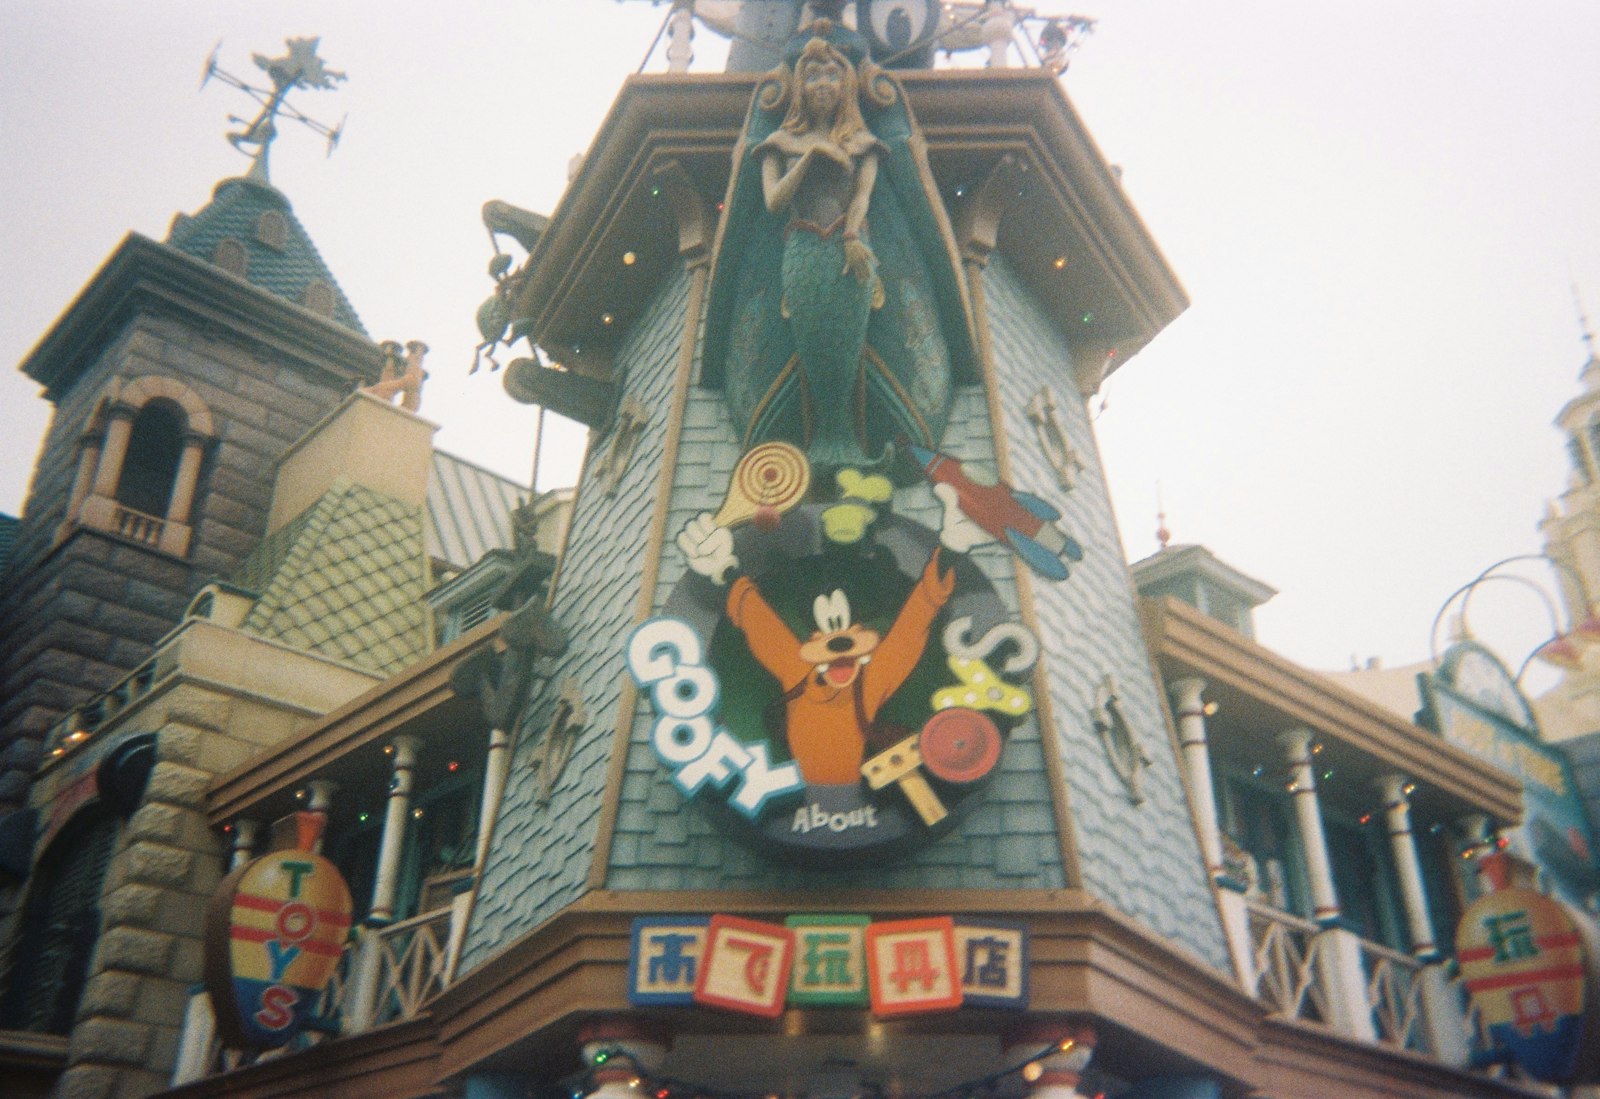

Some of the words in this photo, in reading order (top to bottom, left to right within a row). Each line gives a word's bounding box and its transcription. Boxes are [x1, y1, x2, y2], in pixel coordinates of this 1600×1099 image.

[626, 616, 803, 819] GOOFY
[791, 803, 879, 834] About
[859, 615, 1040, 828] TOYS
[256, 861, 315, 1030] TOYS
